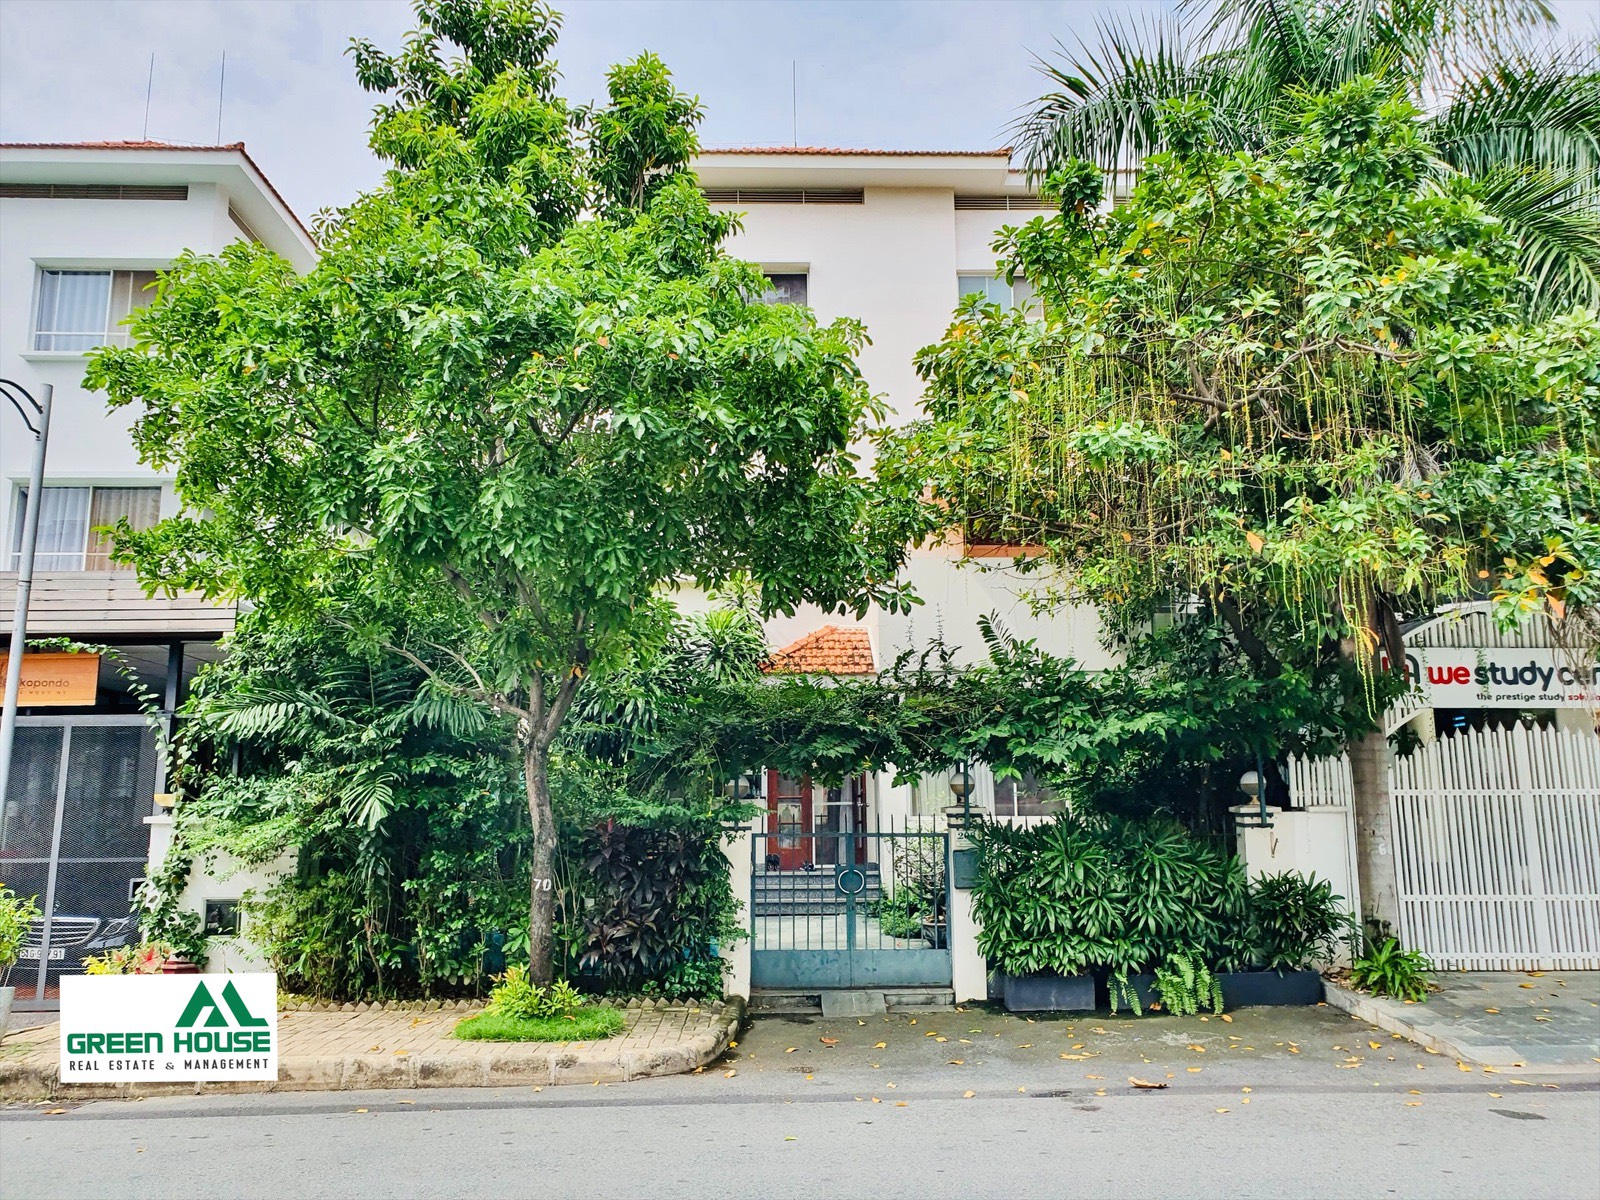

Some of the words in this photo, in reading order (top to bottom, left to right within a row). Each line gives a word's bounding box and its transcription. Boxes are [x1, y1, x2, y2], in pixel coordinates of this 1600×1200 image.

[1427, 666, 1471, 685] we
[1474, 660, 1554, 692] study
[1476, 693, 1493, 701] the
[1495, 692, 1536, 702] prestige
[1538, 693, 1565, 702] study
[533, 878, 552, 892] 70
